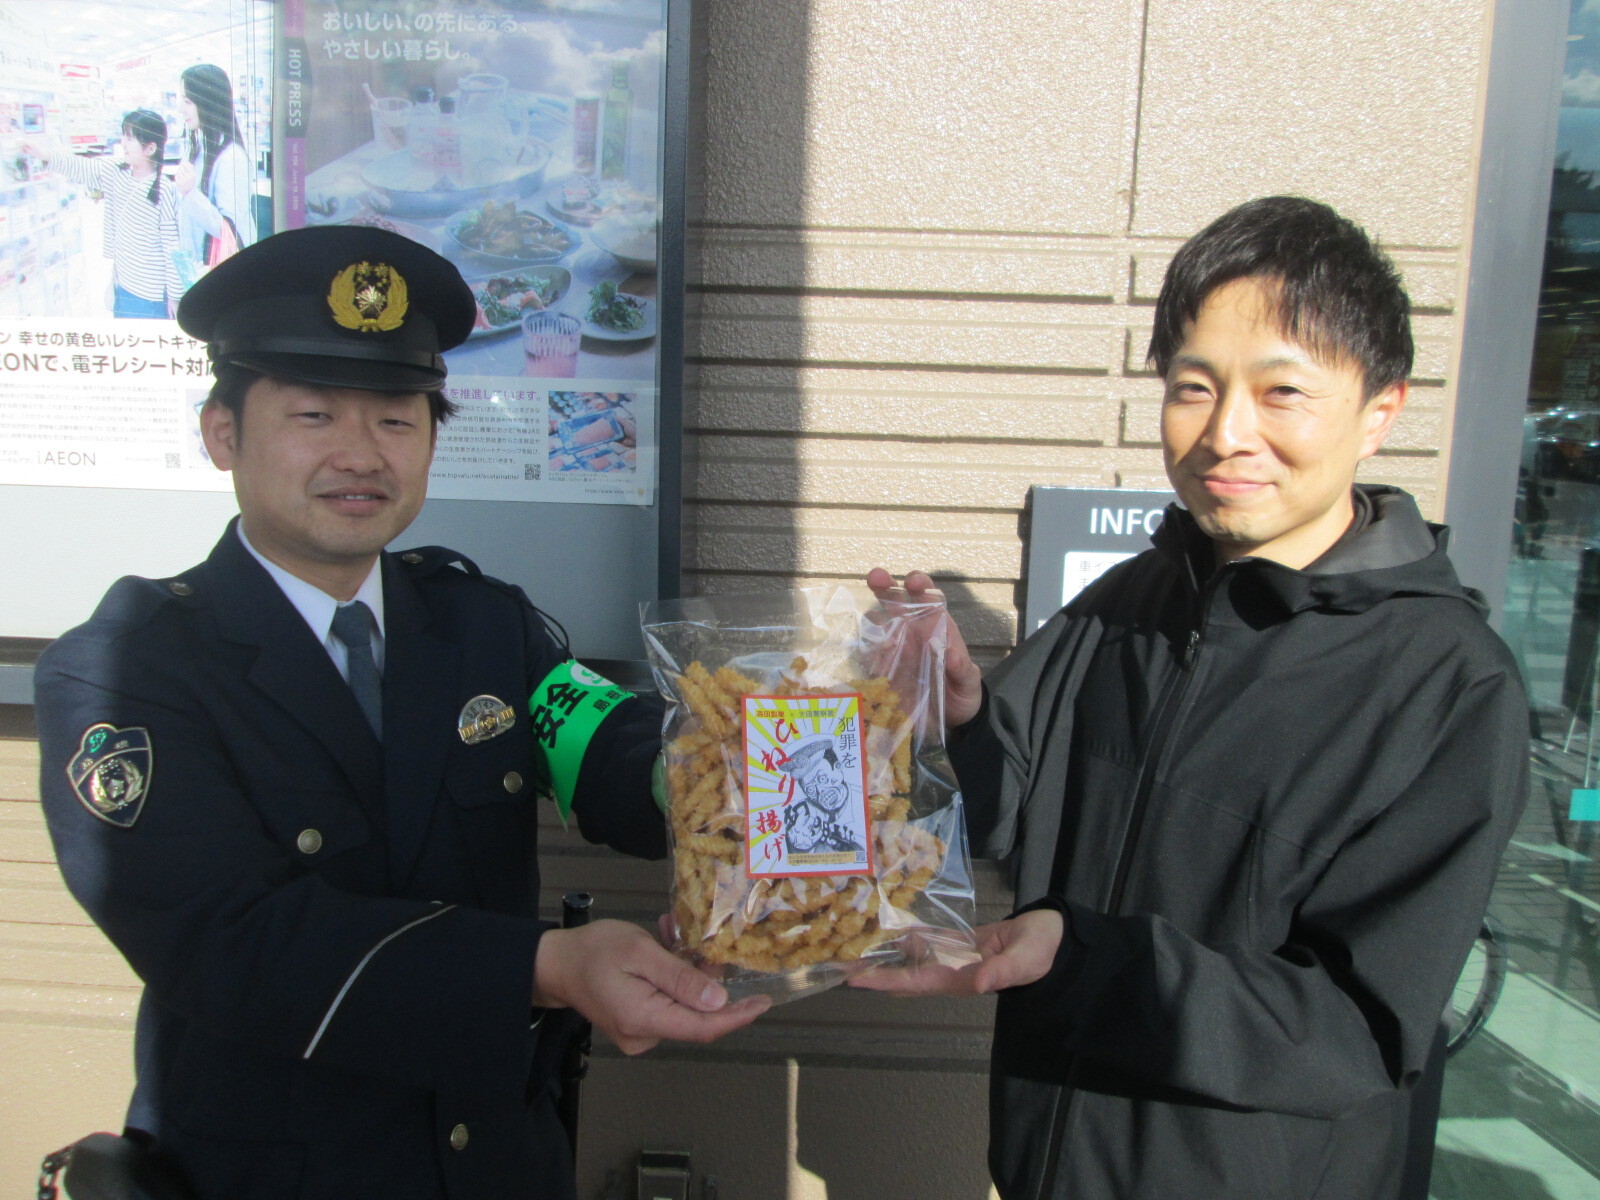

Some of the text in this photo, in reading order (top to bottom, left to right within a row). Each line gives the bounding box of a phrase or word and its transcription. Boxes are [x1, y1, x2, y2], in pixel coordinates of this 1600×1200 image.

[322, 11, 528, 34] おいしい、の先にある、
[322, 39, 471, 61] やさしい暮らし。
[289, 49, 302, 127] HOT PRESS
[838, 716, 858, 769] 犯罪を
